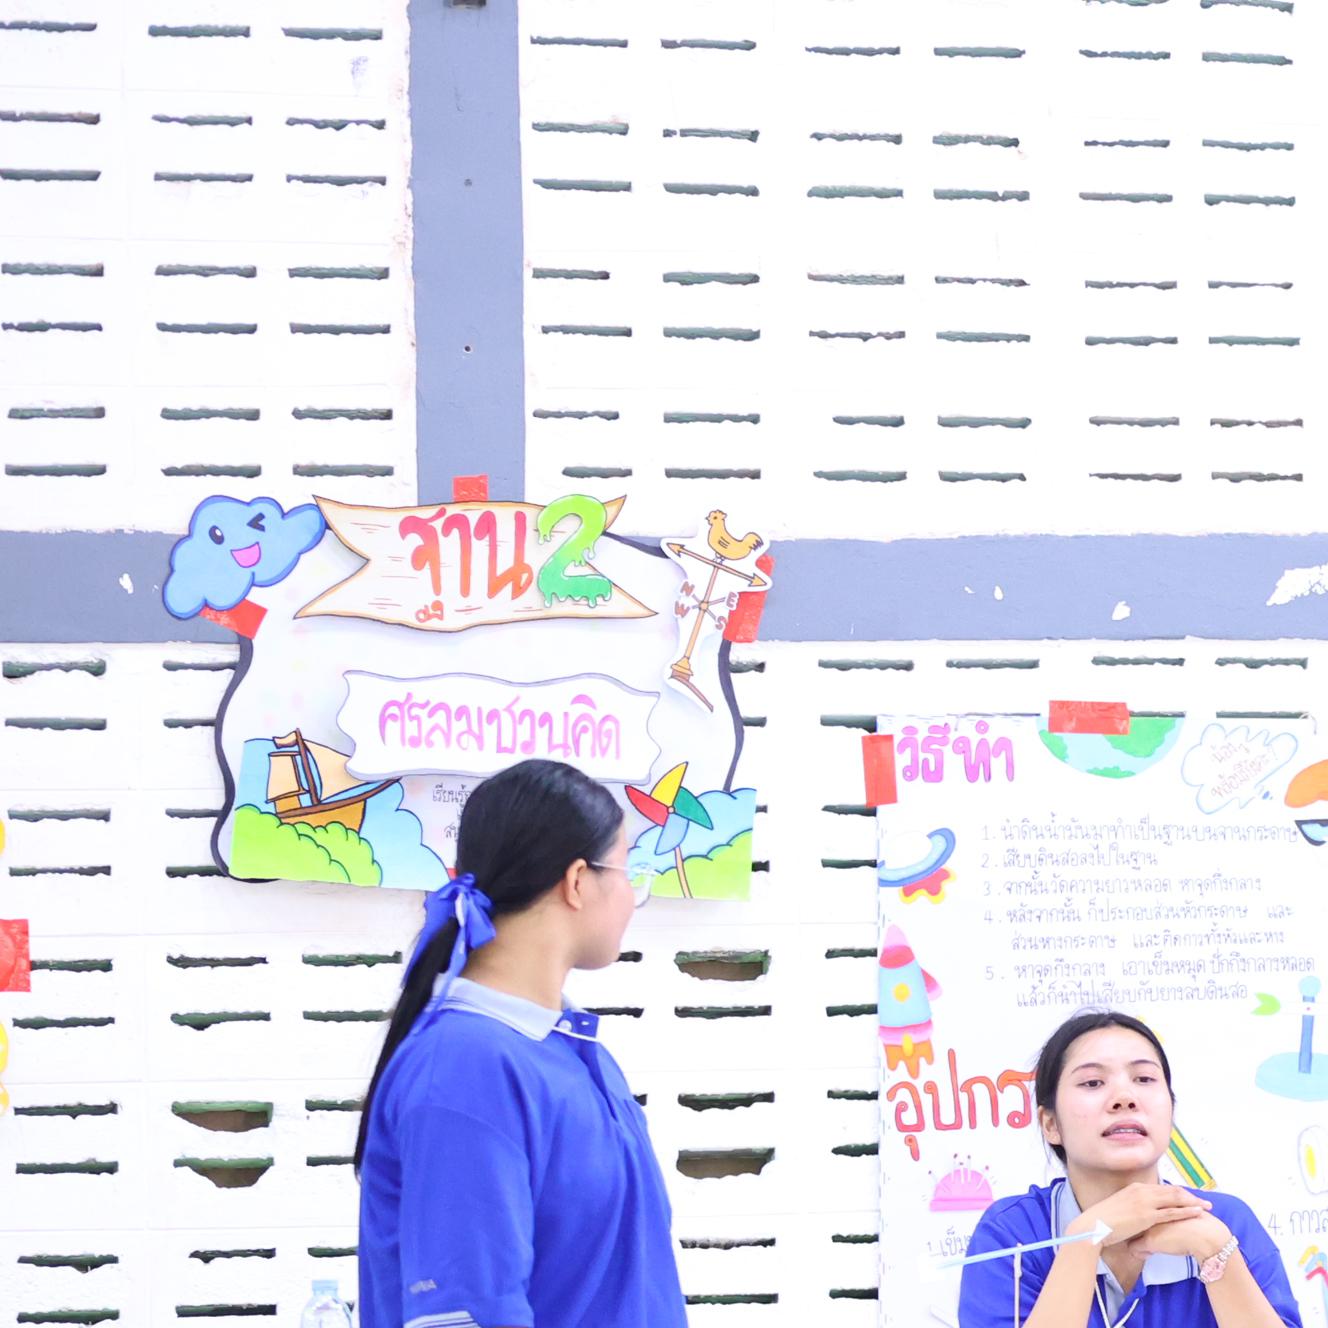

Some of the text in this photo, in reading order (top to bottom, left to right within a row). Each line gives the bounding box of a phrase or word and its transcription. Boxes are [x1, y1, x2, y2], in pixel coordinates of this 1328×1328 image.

[679, 581, 695, 597] N
[726, 591, 738, 609] E
[715, 616, 727, 630] S
[378, 691, 621, 761] ศรลมชวนคิด
[897, 719, 1015, 784] วิธีทำ
[980, 853, 998, 869] 2.
[983, 880, 1001, 897] 3.
[1267, 1212, 1284, 1237] 4.
